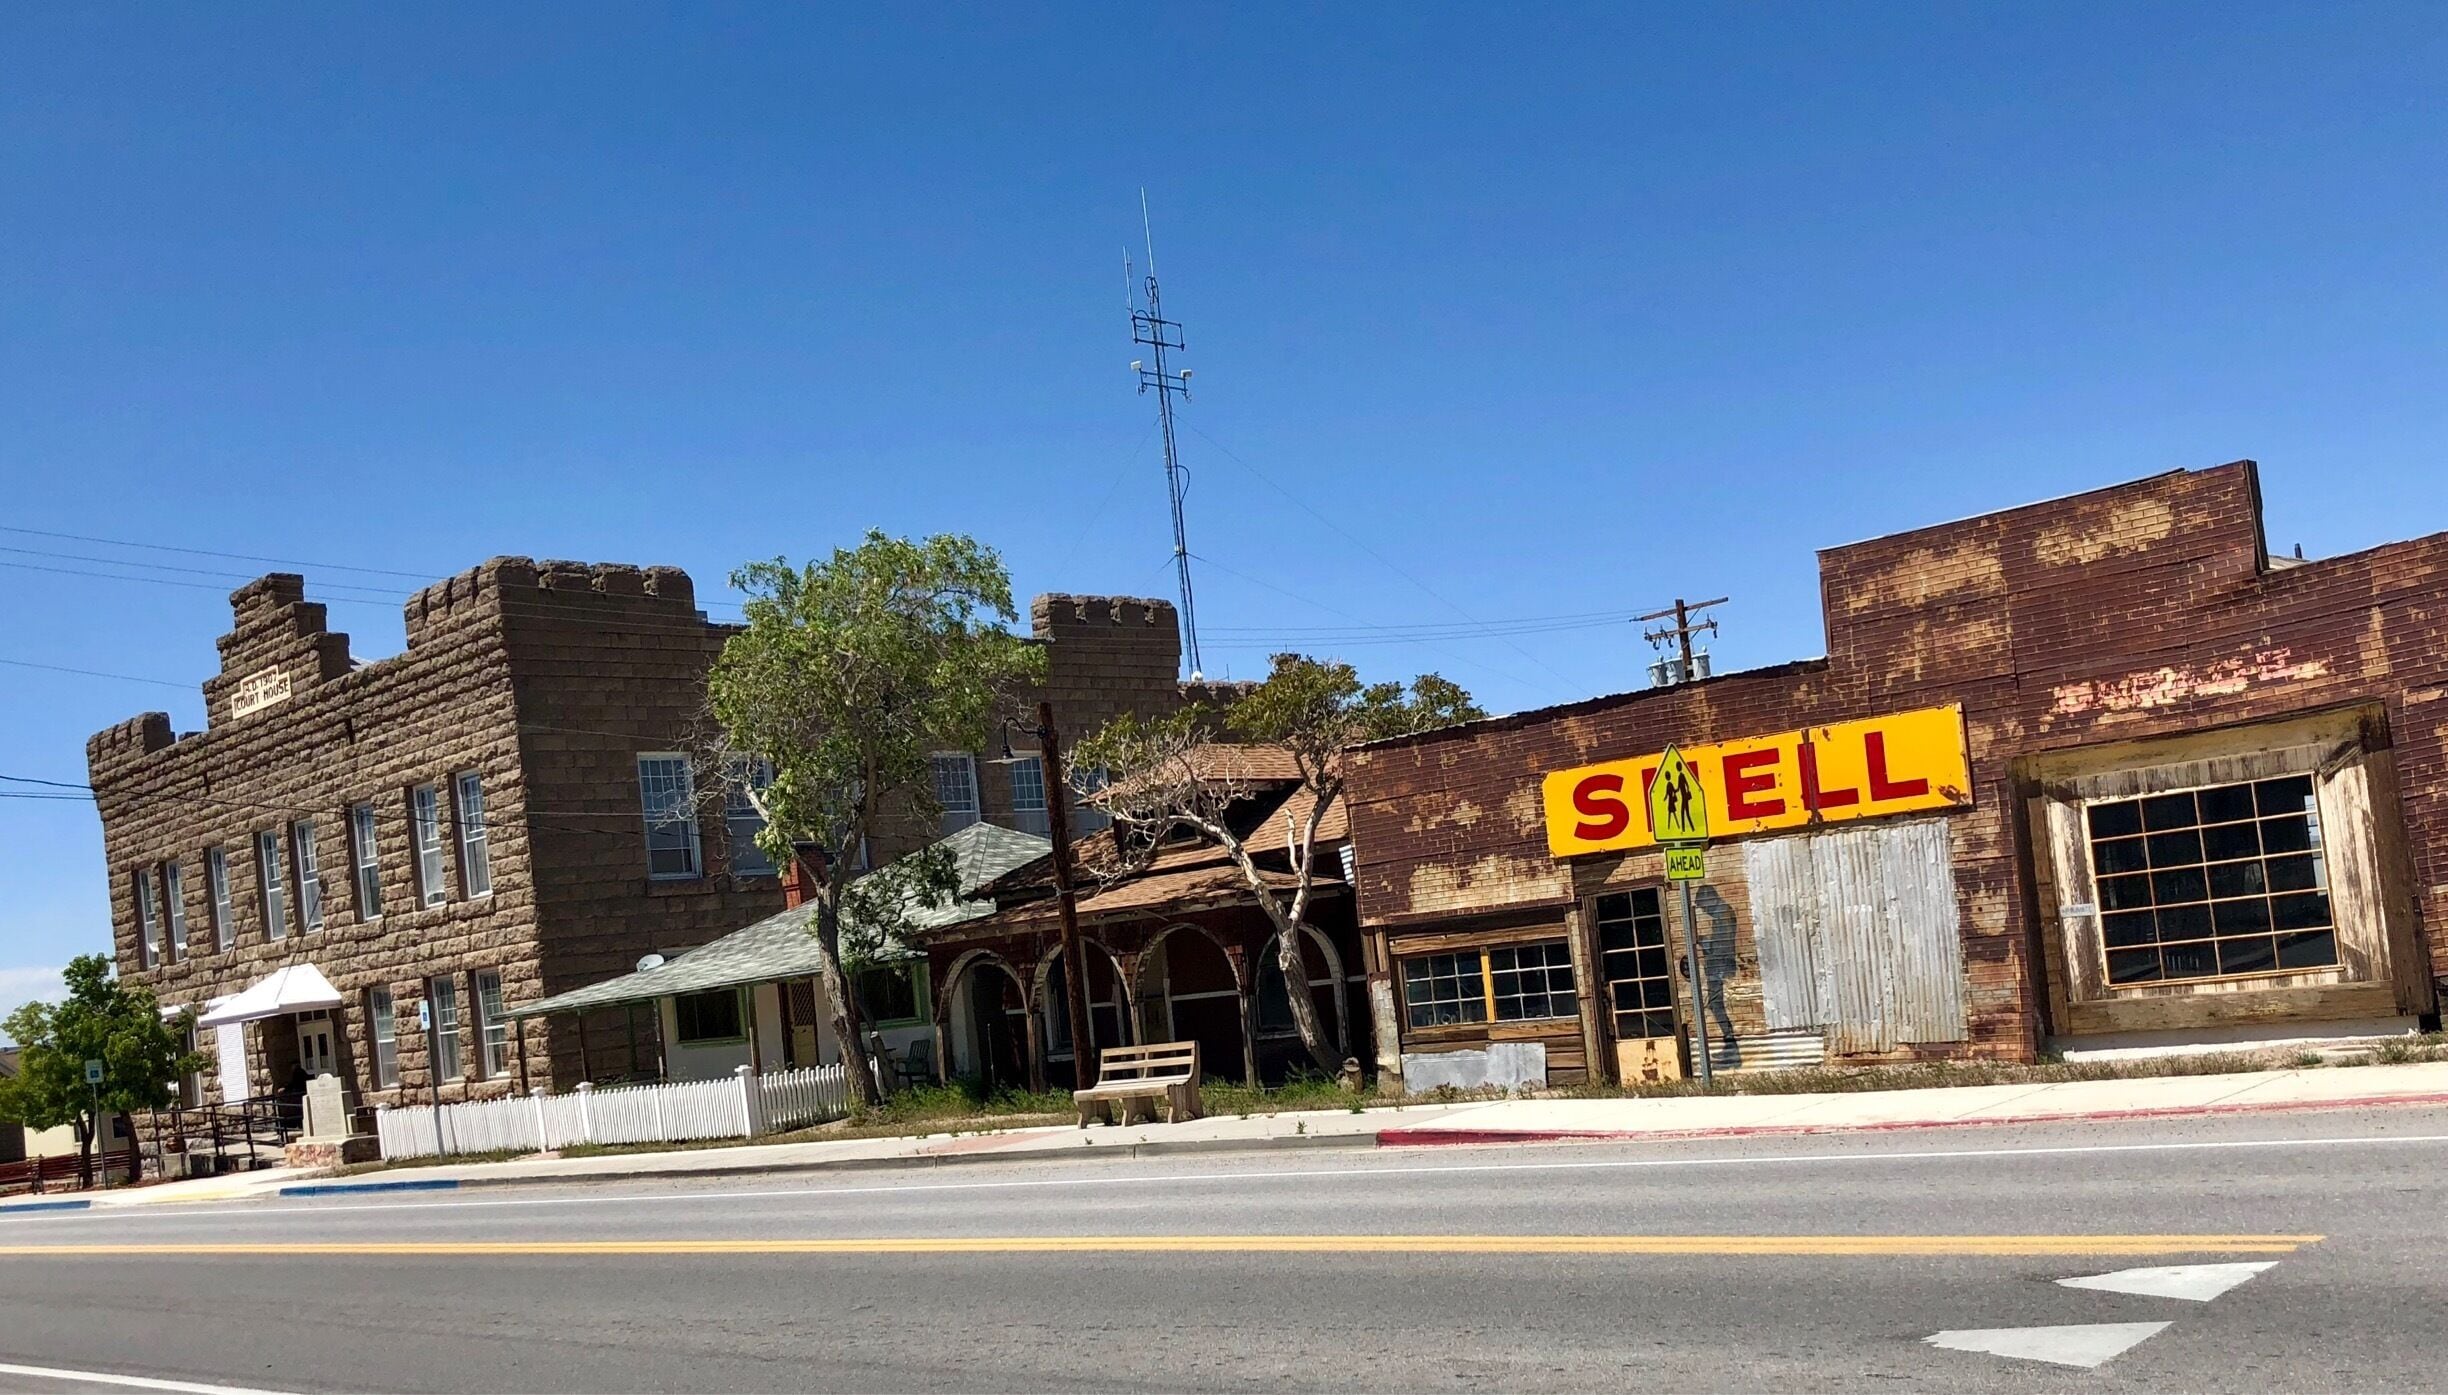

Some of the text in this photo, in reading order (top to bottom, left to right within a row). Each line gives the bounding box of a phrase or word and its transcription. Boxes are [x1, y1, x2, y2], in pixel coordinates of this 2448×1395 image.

[237, 678, 289, 710] COURT HOUSE
[1573, 731, 1929, 840] SELL
[1670, 855, 1701, 872] AHEAD
